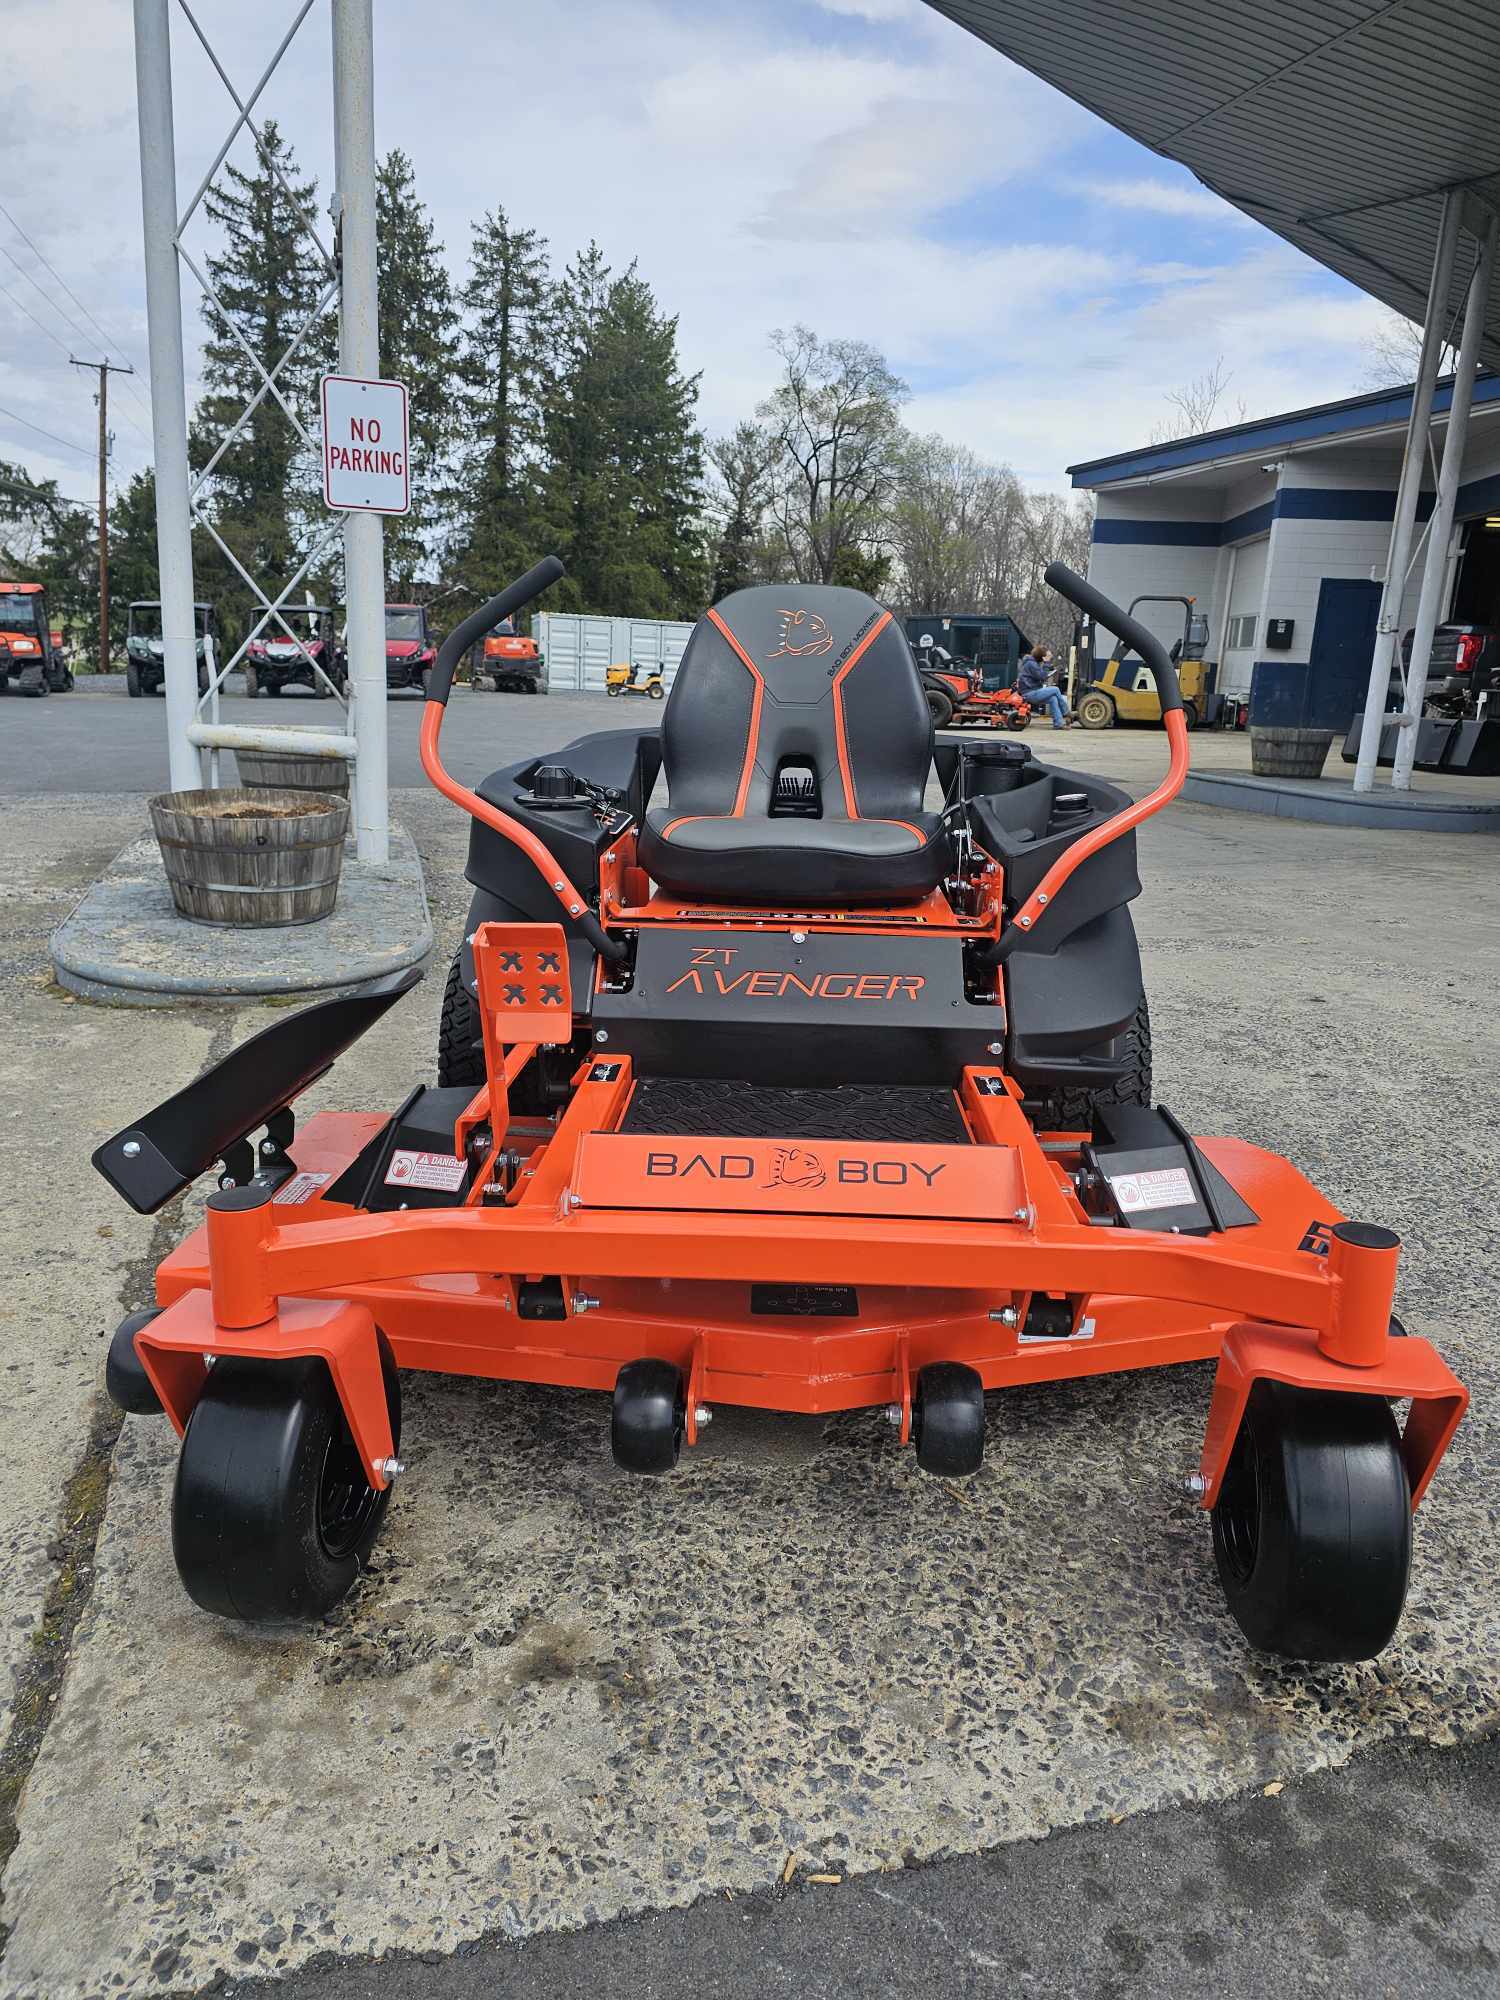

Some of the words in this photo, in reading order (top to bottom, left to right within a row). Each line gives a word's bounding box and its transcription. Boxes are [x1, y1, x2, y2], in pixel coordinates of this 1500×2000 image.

[351, 417, 381, 443] NO
[331, 446, 402, 475] PARKING
[827, 659, 842, 677] BAD
[840, 642, 853, 659] BOY
[853, 612, 879, 641] MOWERS
[690, 947, 739, 965] ZT
[665, 969, 926, 1000] AVENGER
[431, 1156, 465, 1168] DANGER
[646, 1152, 755, 1179] BAD
[838, 1159, 947, 1187] BOY
